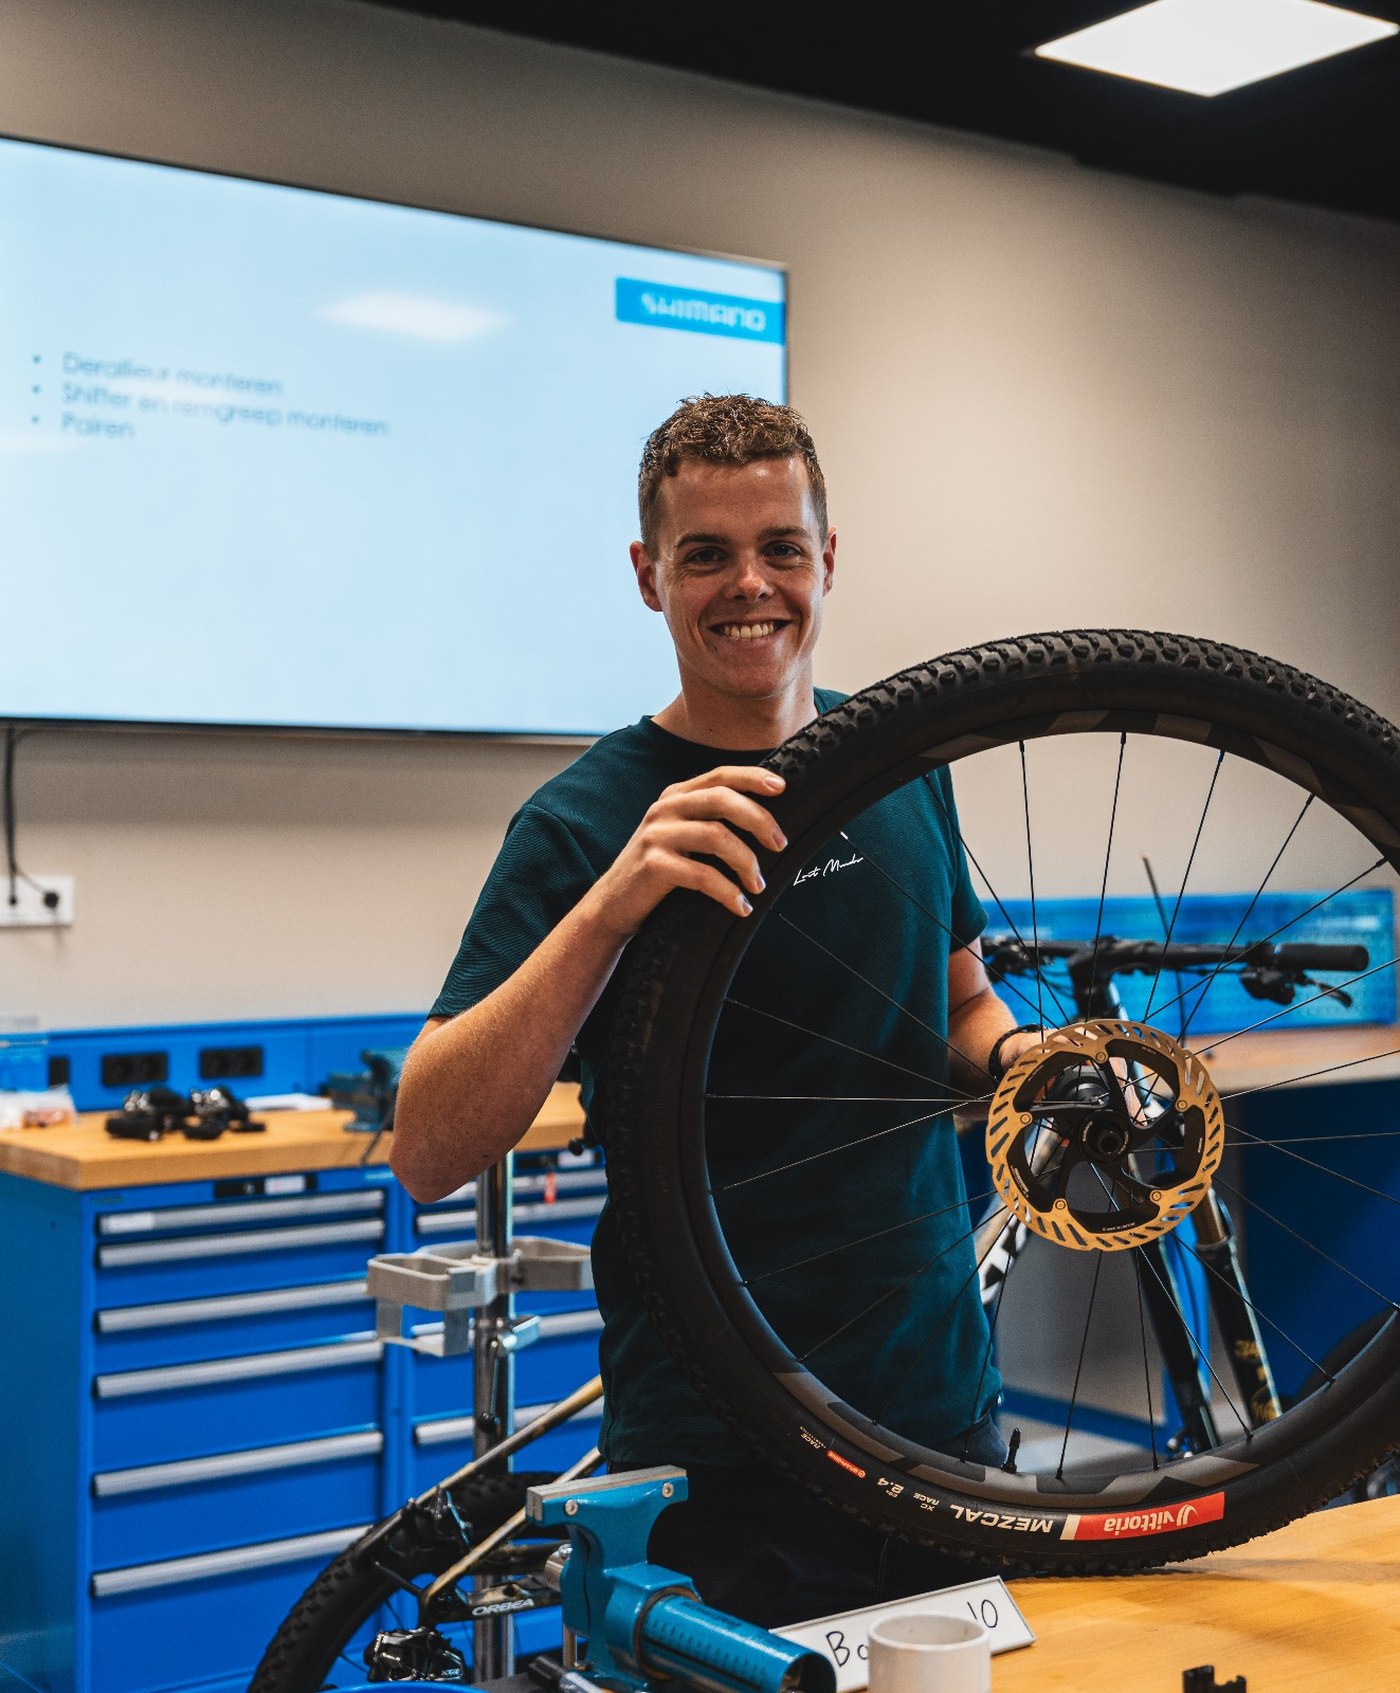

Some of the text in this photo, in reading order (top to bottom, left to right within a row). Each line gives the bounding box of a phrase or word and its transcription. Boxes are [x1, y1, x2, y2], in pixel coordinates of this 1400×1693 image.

[640, 292, 767, 332] SHIMANO
[175, 366, 284, 396] monteren
[61, 410, 136, 439] Pairen
[287, 408, 389, 437] monteren
[877, 1477, 905, 1494] 2.4
[912, 1492, 940, 1506] RACE
[920, 1502, 936, 1512] XC
[949, 1503, 1175, 1536] vittoria MEZCAL
[472, 1598, 535, 1617] ORBEA
